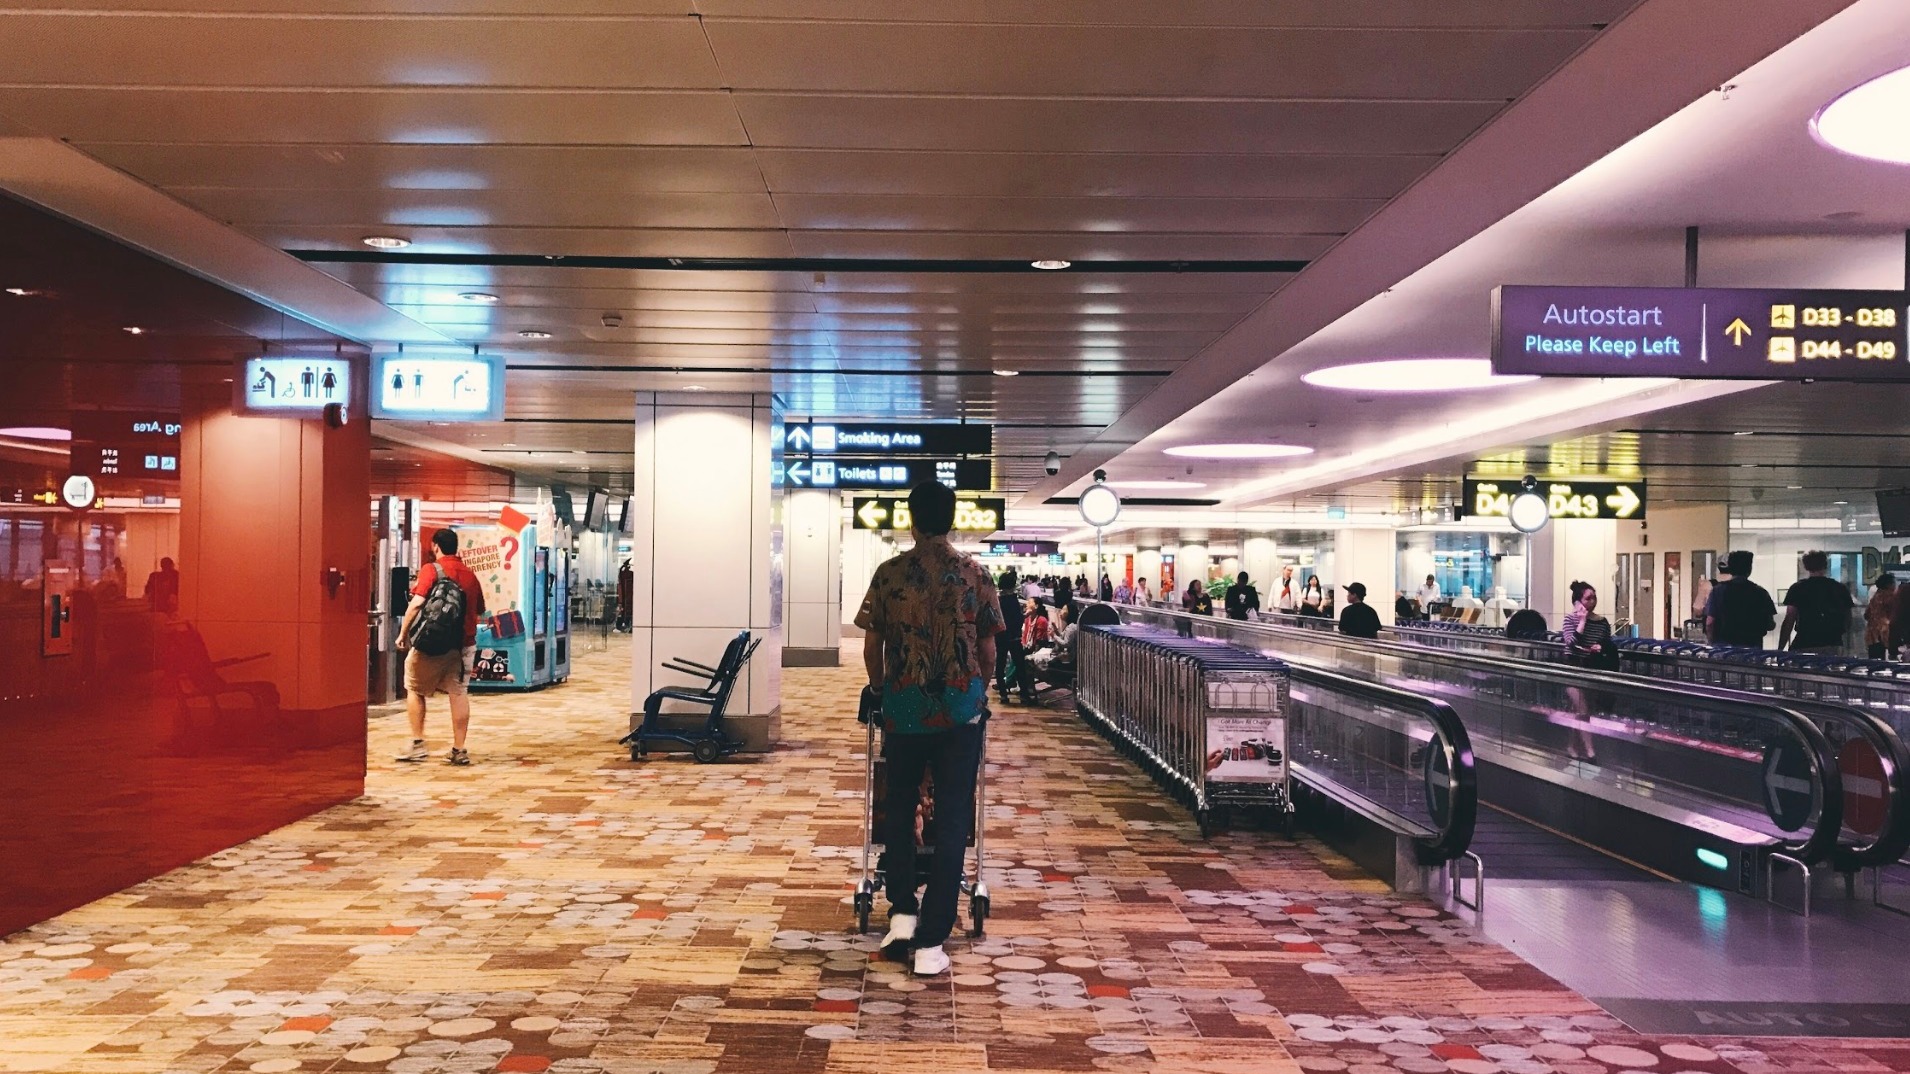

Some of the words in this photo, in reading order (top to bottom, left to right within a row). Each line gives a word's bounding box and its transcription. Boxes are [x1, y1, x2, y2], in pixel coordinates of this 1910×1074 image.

[1543, 303, 1663, 326] Autostart
[1802, 307, 1841, 327] D33
[1856, 308, 1896, 327] D38
[1525, 335, 1583, 352] Please
[1589, 336, 1636, 357] Keep
[1643, 336, 1681, 354] Left
[1801, 340, 1841, 359] D44
[1856, 341, 1896, 360] D49
[838, 432, 890, 447] Smoking
[892, 432, 921, 445] Area
[838, 467, 876, 480] Toilets
[1476, 493, 1515, 516] D4
[1549, 494, 1599, 518] D43
[955, 509, 997, 529] D32
[464, 553, 500, 567] INGAPORE
[1693, 1010, 1851, 1028] AUTO
